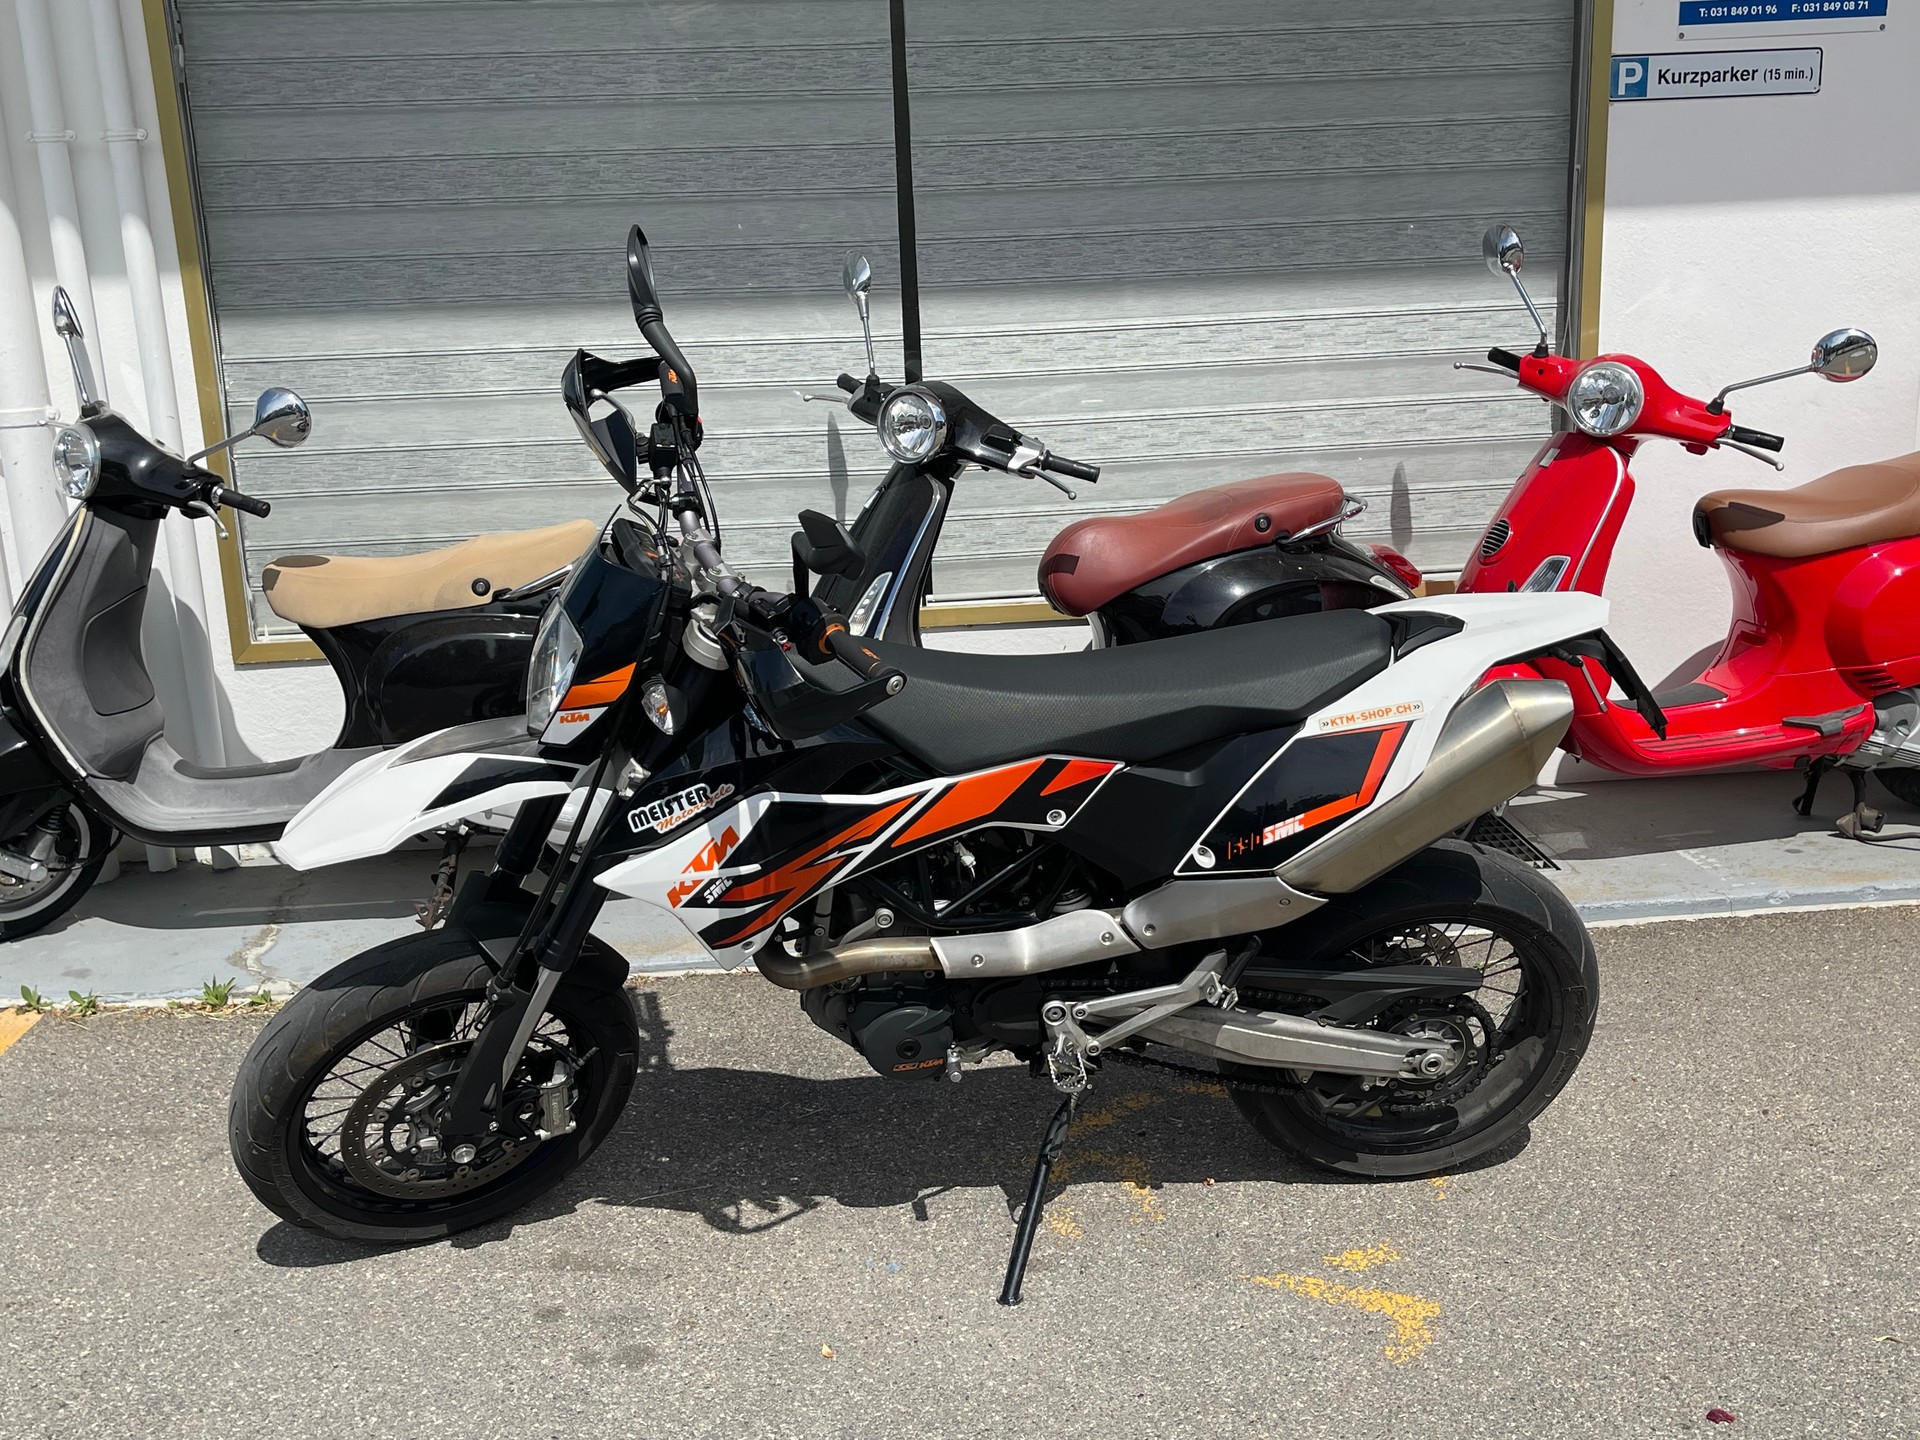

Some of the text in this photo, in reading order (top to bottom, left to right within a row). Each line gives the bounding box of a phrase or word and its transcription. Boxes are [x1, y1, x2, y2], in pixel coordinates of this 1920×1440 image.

[1699, 0, 1869, 17] T: 031 849 01 96 F: 031 849 08 71
[1617, 61, 1814, 96] P Kurzparker (15 min.)
[559, 711, 590, 724] KTM
[630, 785, 711, 830] MEISTER
[656, 785, 734, 832] Motorcycle
[666, 825, 740, 909] KTM
[703, 876, 733, 904] SMC
